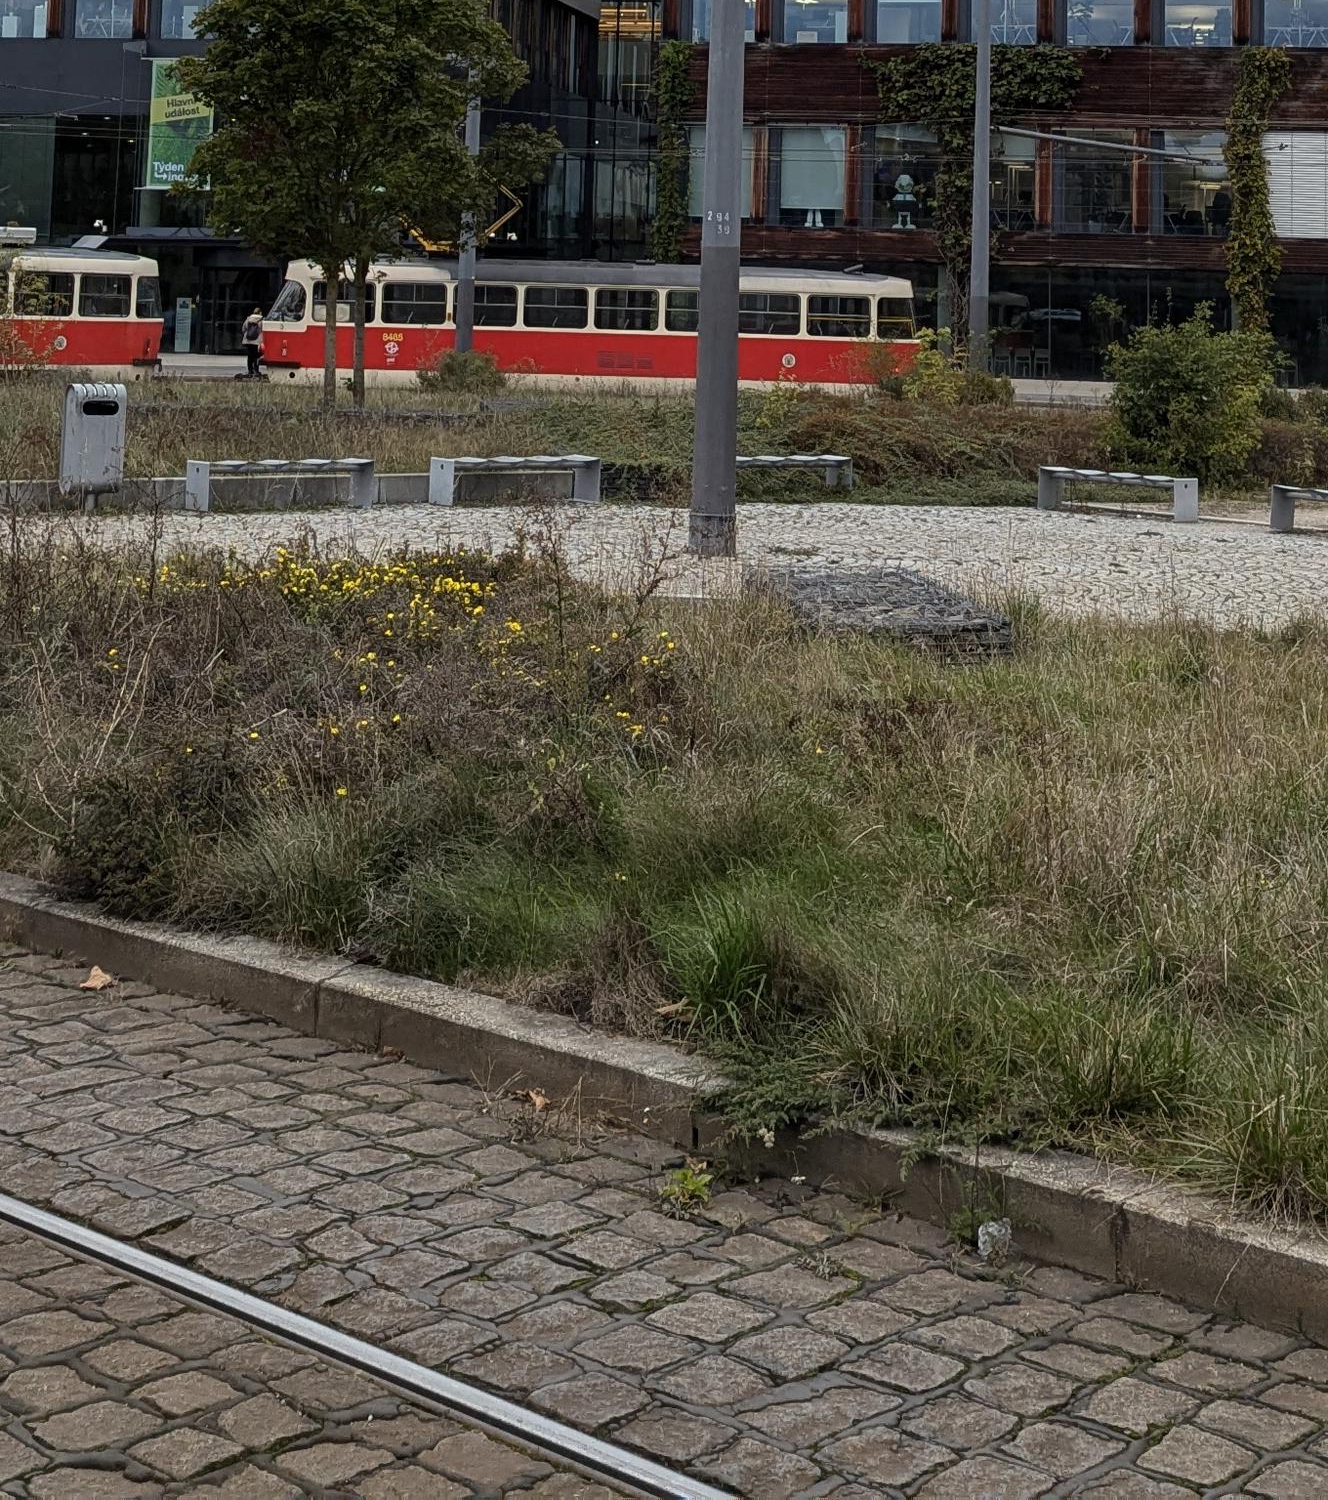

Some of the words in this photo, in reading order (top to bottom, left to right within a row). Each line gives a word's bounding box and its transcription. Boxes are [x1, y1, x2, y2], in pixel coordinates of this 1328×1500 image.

[166, 98, 196, 108] Hlavn
[164, 106, 201, 119] událost
[152, 160, 184, 173] Týden
